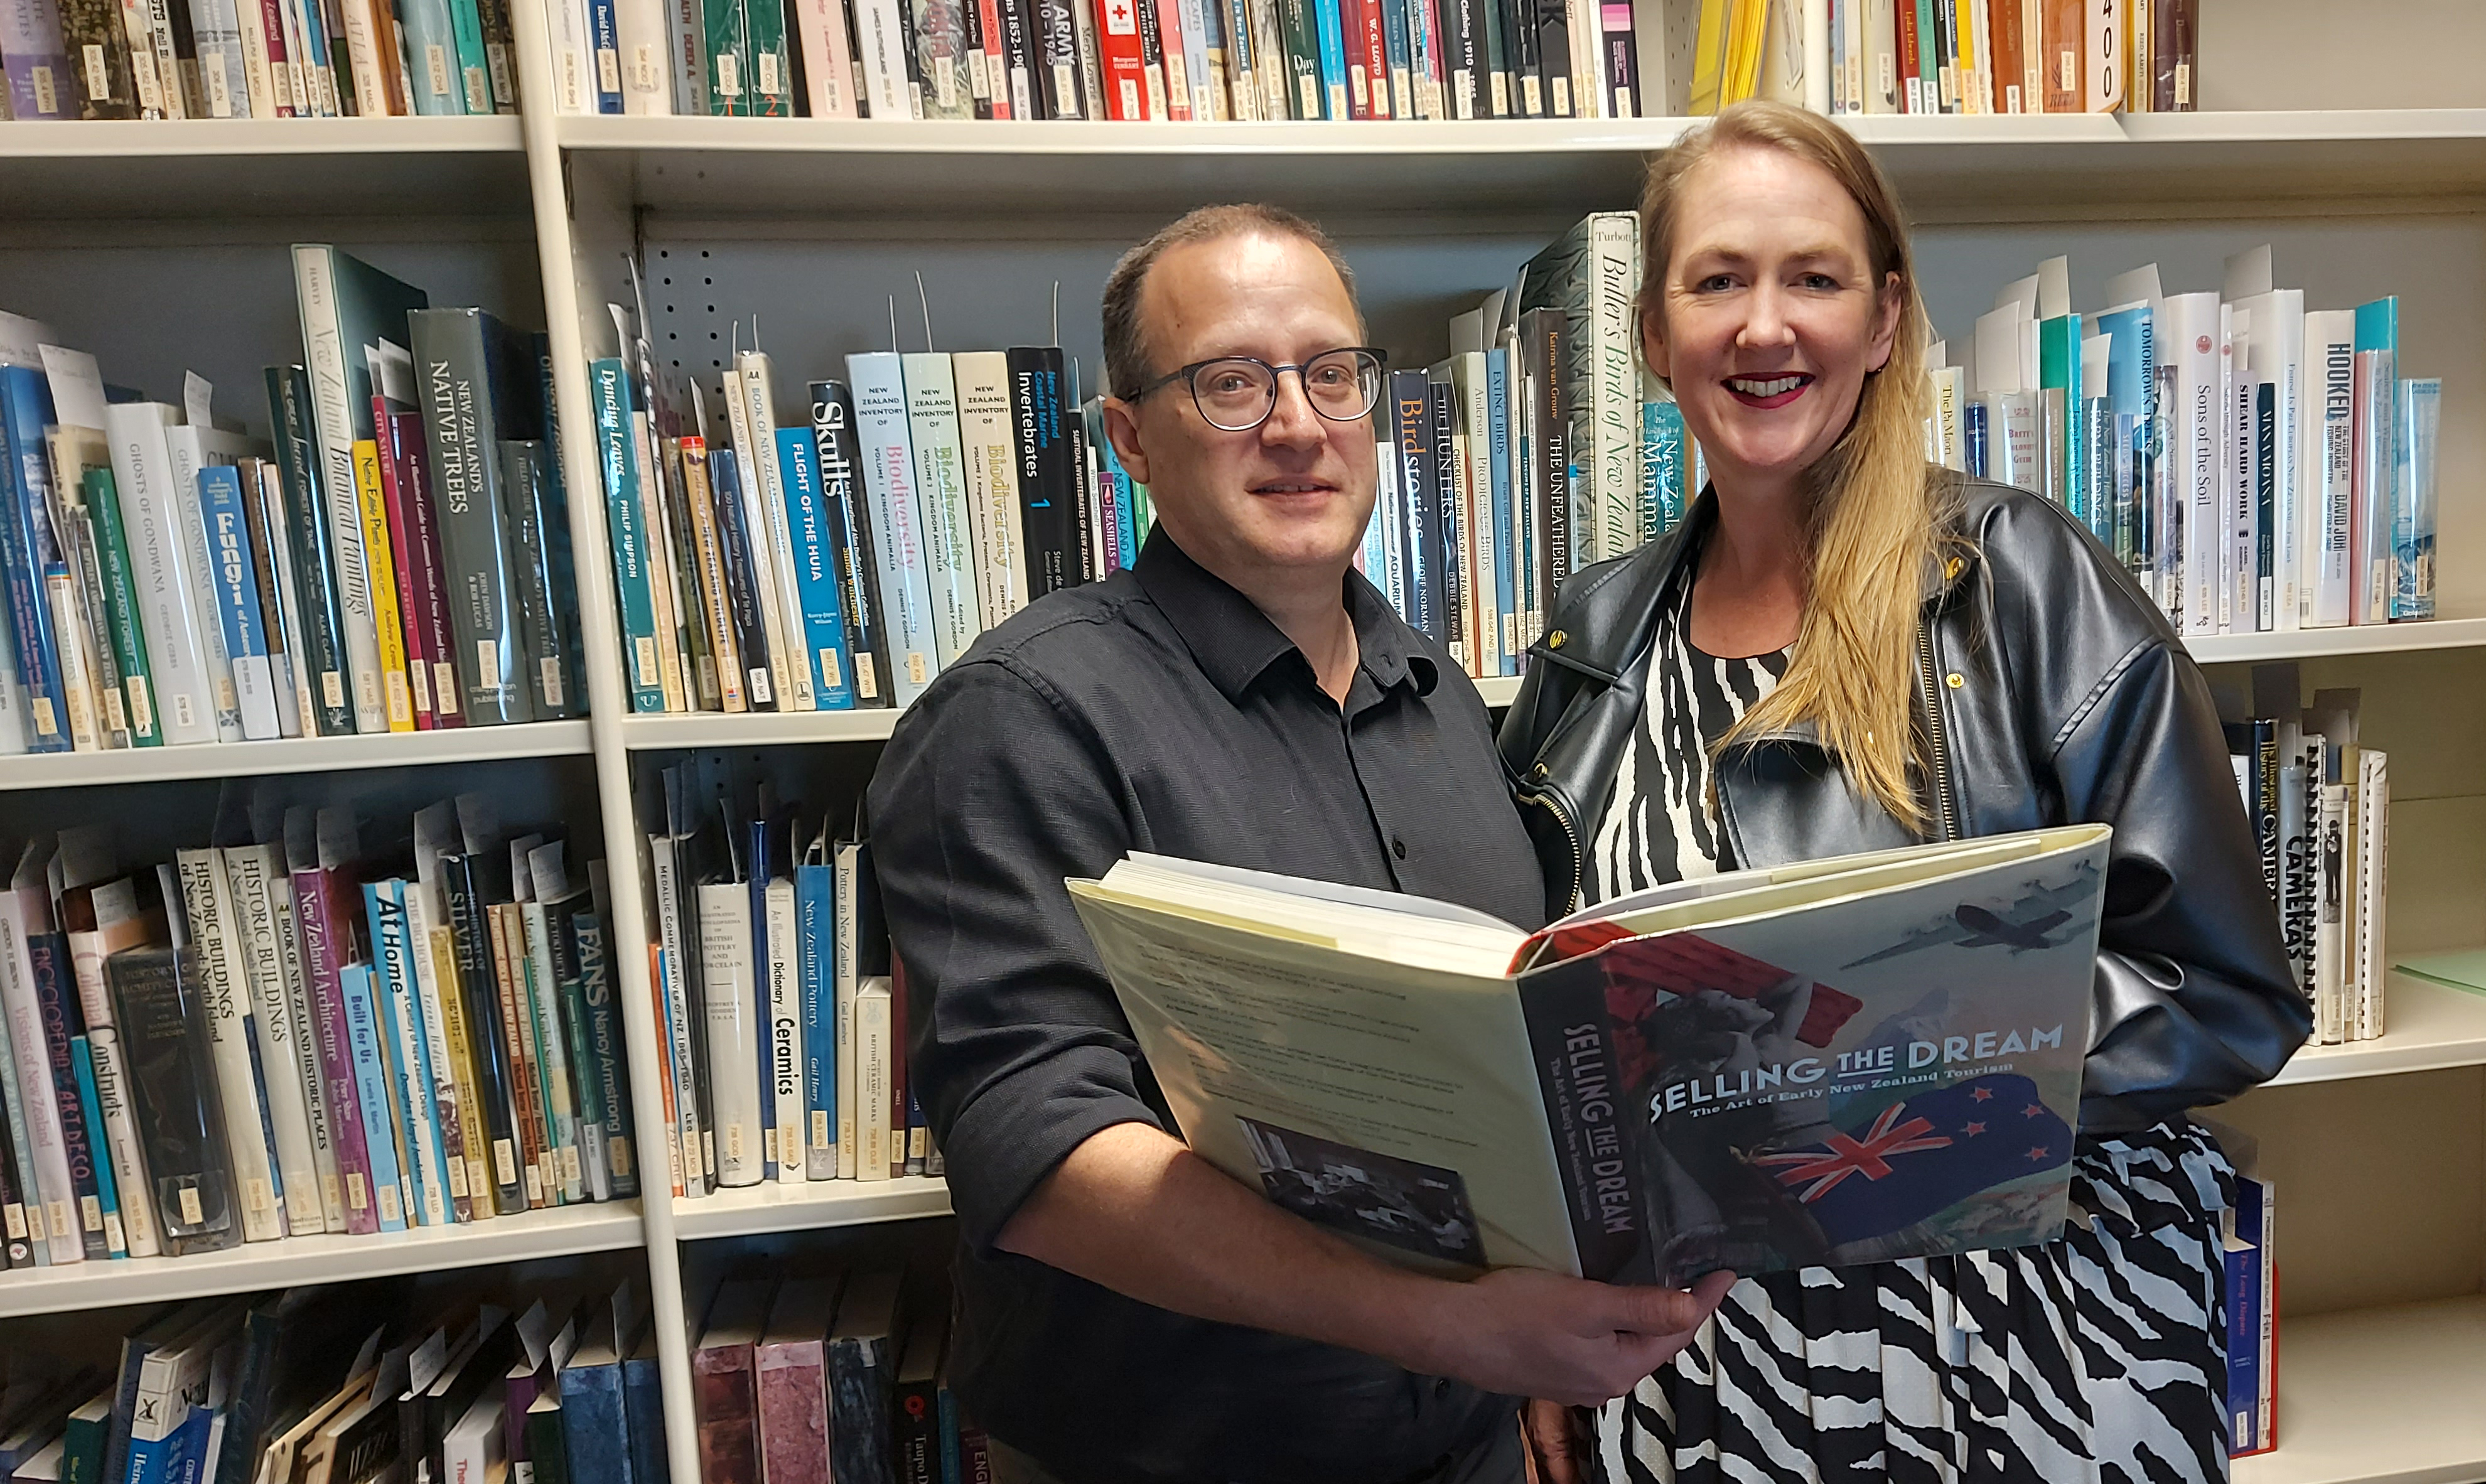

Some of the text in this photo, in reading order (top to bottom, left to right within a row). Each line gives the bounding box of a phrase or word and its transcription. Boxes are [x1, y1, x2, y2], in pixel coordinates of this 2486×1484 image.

[266, 2, 279, 41] Zealand
[876, 30, 887, 75] SUTHERLAND
[1053, 5, 1075, 65] ARMY
[1082, 27, 1092, 59] Meryl
[1235, 16, 1244, 33] New
[1237, 35, 1247, 66] Zealand
[1371, 44, 1381, 75] LLOYD
[1460, 0, 1473, 66] Clothing 1910
[1906, 33, 1915, 65] Edwards
[1595, 232, 1632, 242] Turbott
[1474, 388, 1486, 437] Anderson
[1492, 371, 1505, 454] EXTINCT BIRDS
[1601, 255, 1630, 558] Buller's Birds of New Zealan
[2326, 343, 2350, 418] HOOKED
[374, 411, 391, 476] CITY NATURE
[429, 360, 469, 513] NATIVE TREES
[457, 380, 483, 493] NEW ZEALAND'S
[600, 368, 627, 476] Dancing Leaves
[811, 401, 850, 497] Skulls
[1018, 371, 1038, 477] Invertebrates
[1072, 429, 1082, 463] SUBTIDAL
[2196, 385, 2211, 507] Sons of the Soil
[2239, 384, 2248, 519] SHEAR HARD WORK
[313, 325, 369, 616] New Zealand Botanical Paintings
[886, 445, 916, 570] Biodiversity
[987, 444, 1014, 569] Biodiversity
[1075, 464, 1085, 517] INVERTEBRATES
[1399, 398, 1429, 539] Birdstories
[128, 443, 164, 593] GHOSTS OF GONDWANA
[792, 443, 821, 581] FLIGHT OF THE HUIA
[934, 446, 963, 572] Biodiversity
[1078, 519, 1086, 528] OF
[1104, 509, 1117, 557] SEASHELLS
[1114, 472, 1131, 551] NEW ZEALAND
[1453, 448, 1469, 610] CHECKLIST OF THE BIRDS OF NEW ZEALAND
[1477, 456, 1491, 571] PRODIGIOUS BIRDS
[1549, 435, 1566, 588] THE UNFEATHERE
[478, 571, 493, 630] JOHN DAWSON
[841, 547, 861, 627] Simon Winchester
[1080, 547, 1090, 579] ZEALAND
[1417, 556, 1429, 632] GEOFF NORMAN
[107, 549, 134, 657] NEW ZEALAND FOREST
[159, 604, 178, 669] GEORGE GIBBS
[317, 613, 333, 668] ALAN CLARKE
[2261, 814, 2278, 901] CAMER
[449, 892, 474, 972] SILVER
[772, 910, 783, 921] An
[837, 868, 851, 978] Pottery in New Zealand
[2284, 836, 2305, 960] CAMERAS
[194, 861, 234, 1019] HISTORIC BUILDINGS
[242, 859, 288, 1043] HISTORIC BUILDINGS
[299, 891, 340, 1062] New Zealand Architecture
[376, 896, 403, 993] At Home
[578, 927, 609, 1006] FANS
[804, 900, 820, 1028] New Zealand Pottery
[772, 962, 787, 1005] Dictionary
[841, 1001, 849, 1045] Gail Lambert
[281, 918, 328, 1150] BOOK OF NEW ZEALAND HISTORIC PLACES
[350, 995, 372, 1064] Built for Us
[775, 1018, 799, 1095] Ceramics
[591, 1009, 623, 1132] Nancy Armstrong
[809, 1058, 821, 1102] Gail Henry
[1648, 1024, 2063, 1124] SELLING THE DREAM
[1689, 1062, 2013, 1119] The Art of Early New Zealand Tourism
[1563, 1023, 1634, 1234] SELLING THE DREAM
[131, 1453, 148, 1484] Hein
[913, 1434, 927, 1472] Taupo
[974, 1451, 987, 1484] ENG
